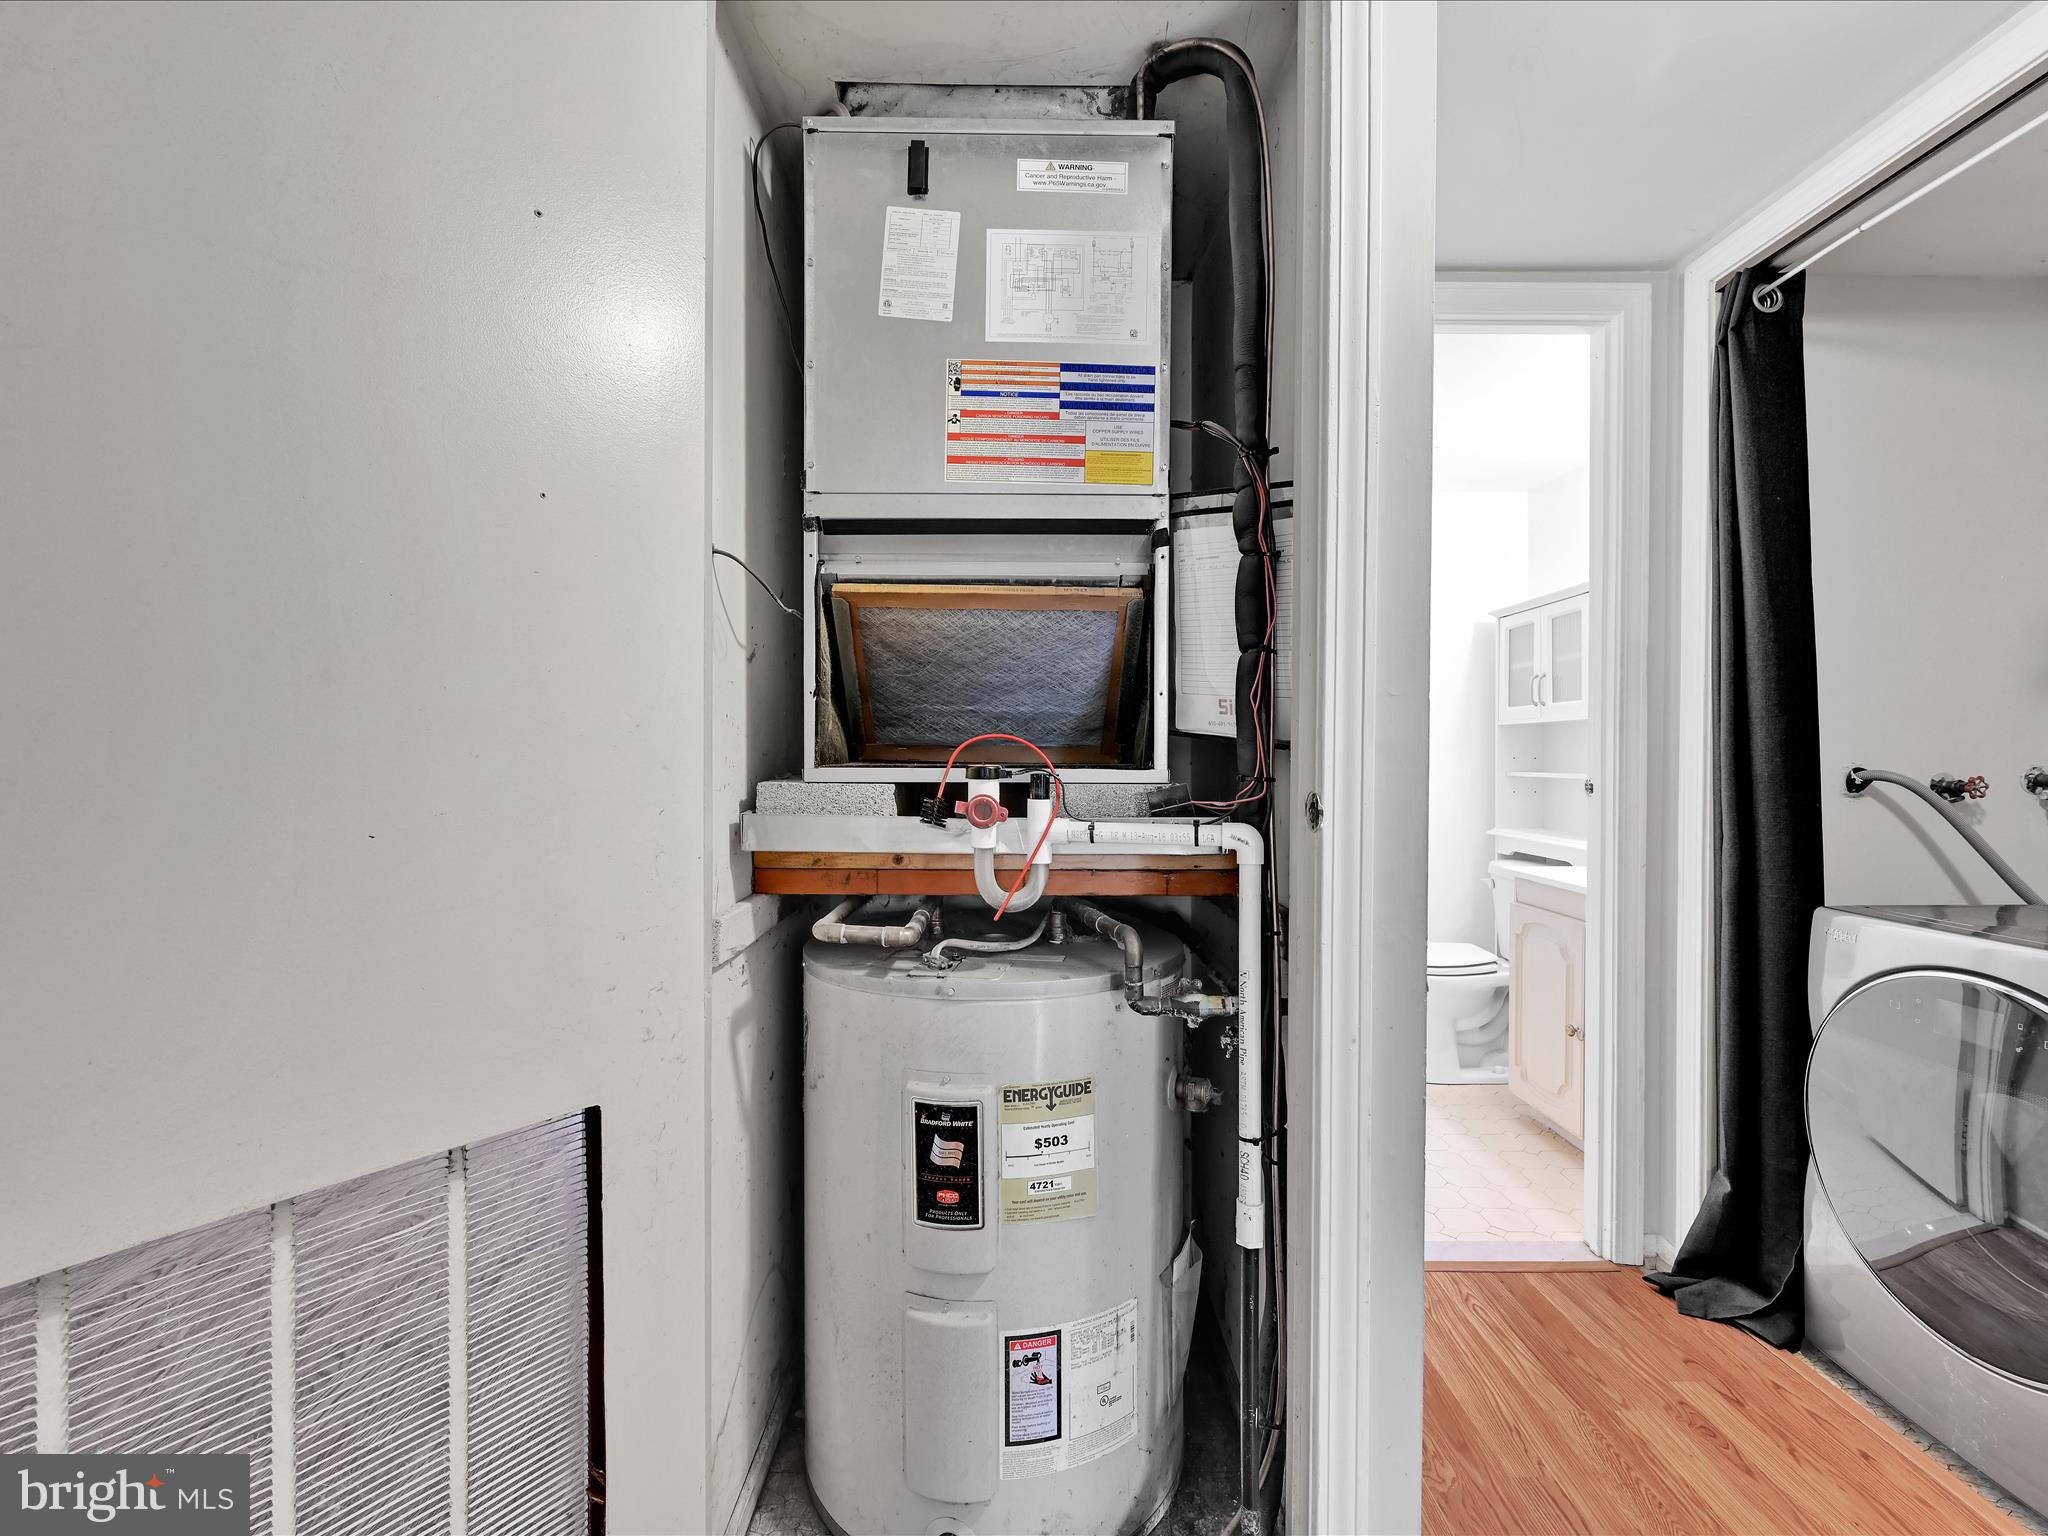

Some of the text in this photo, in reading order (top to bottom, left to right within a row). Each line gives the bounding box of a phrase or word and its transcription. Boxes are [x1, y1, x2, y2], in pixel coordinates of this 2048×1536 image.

[1218, 699, 1233, 715] Si
[1239, 1047, 1247, 1066] Pipe
[1004, 1081, 1092, 1103] ENERGYGUIDE
[920, 1118, 951, 1126] BRADFORD
[1034, 1134, 1069, 1150] $503
[1240, 1150, 1249, 1180] SCH40
[1030, 1180, 1054, 1190] 4721
[1022, 1338, 1052, 1349] DANGER
